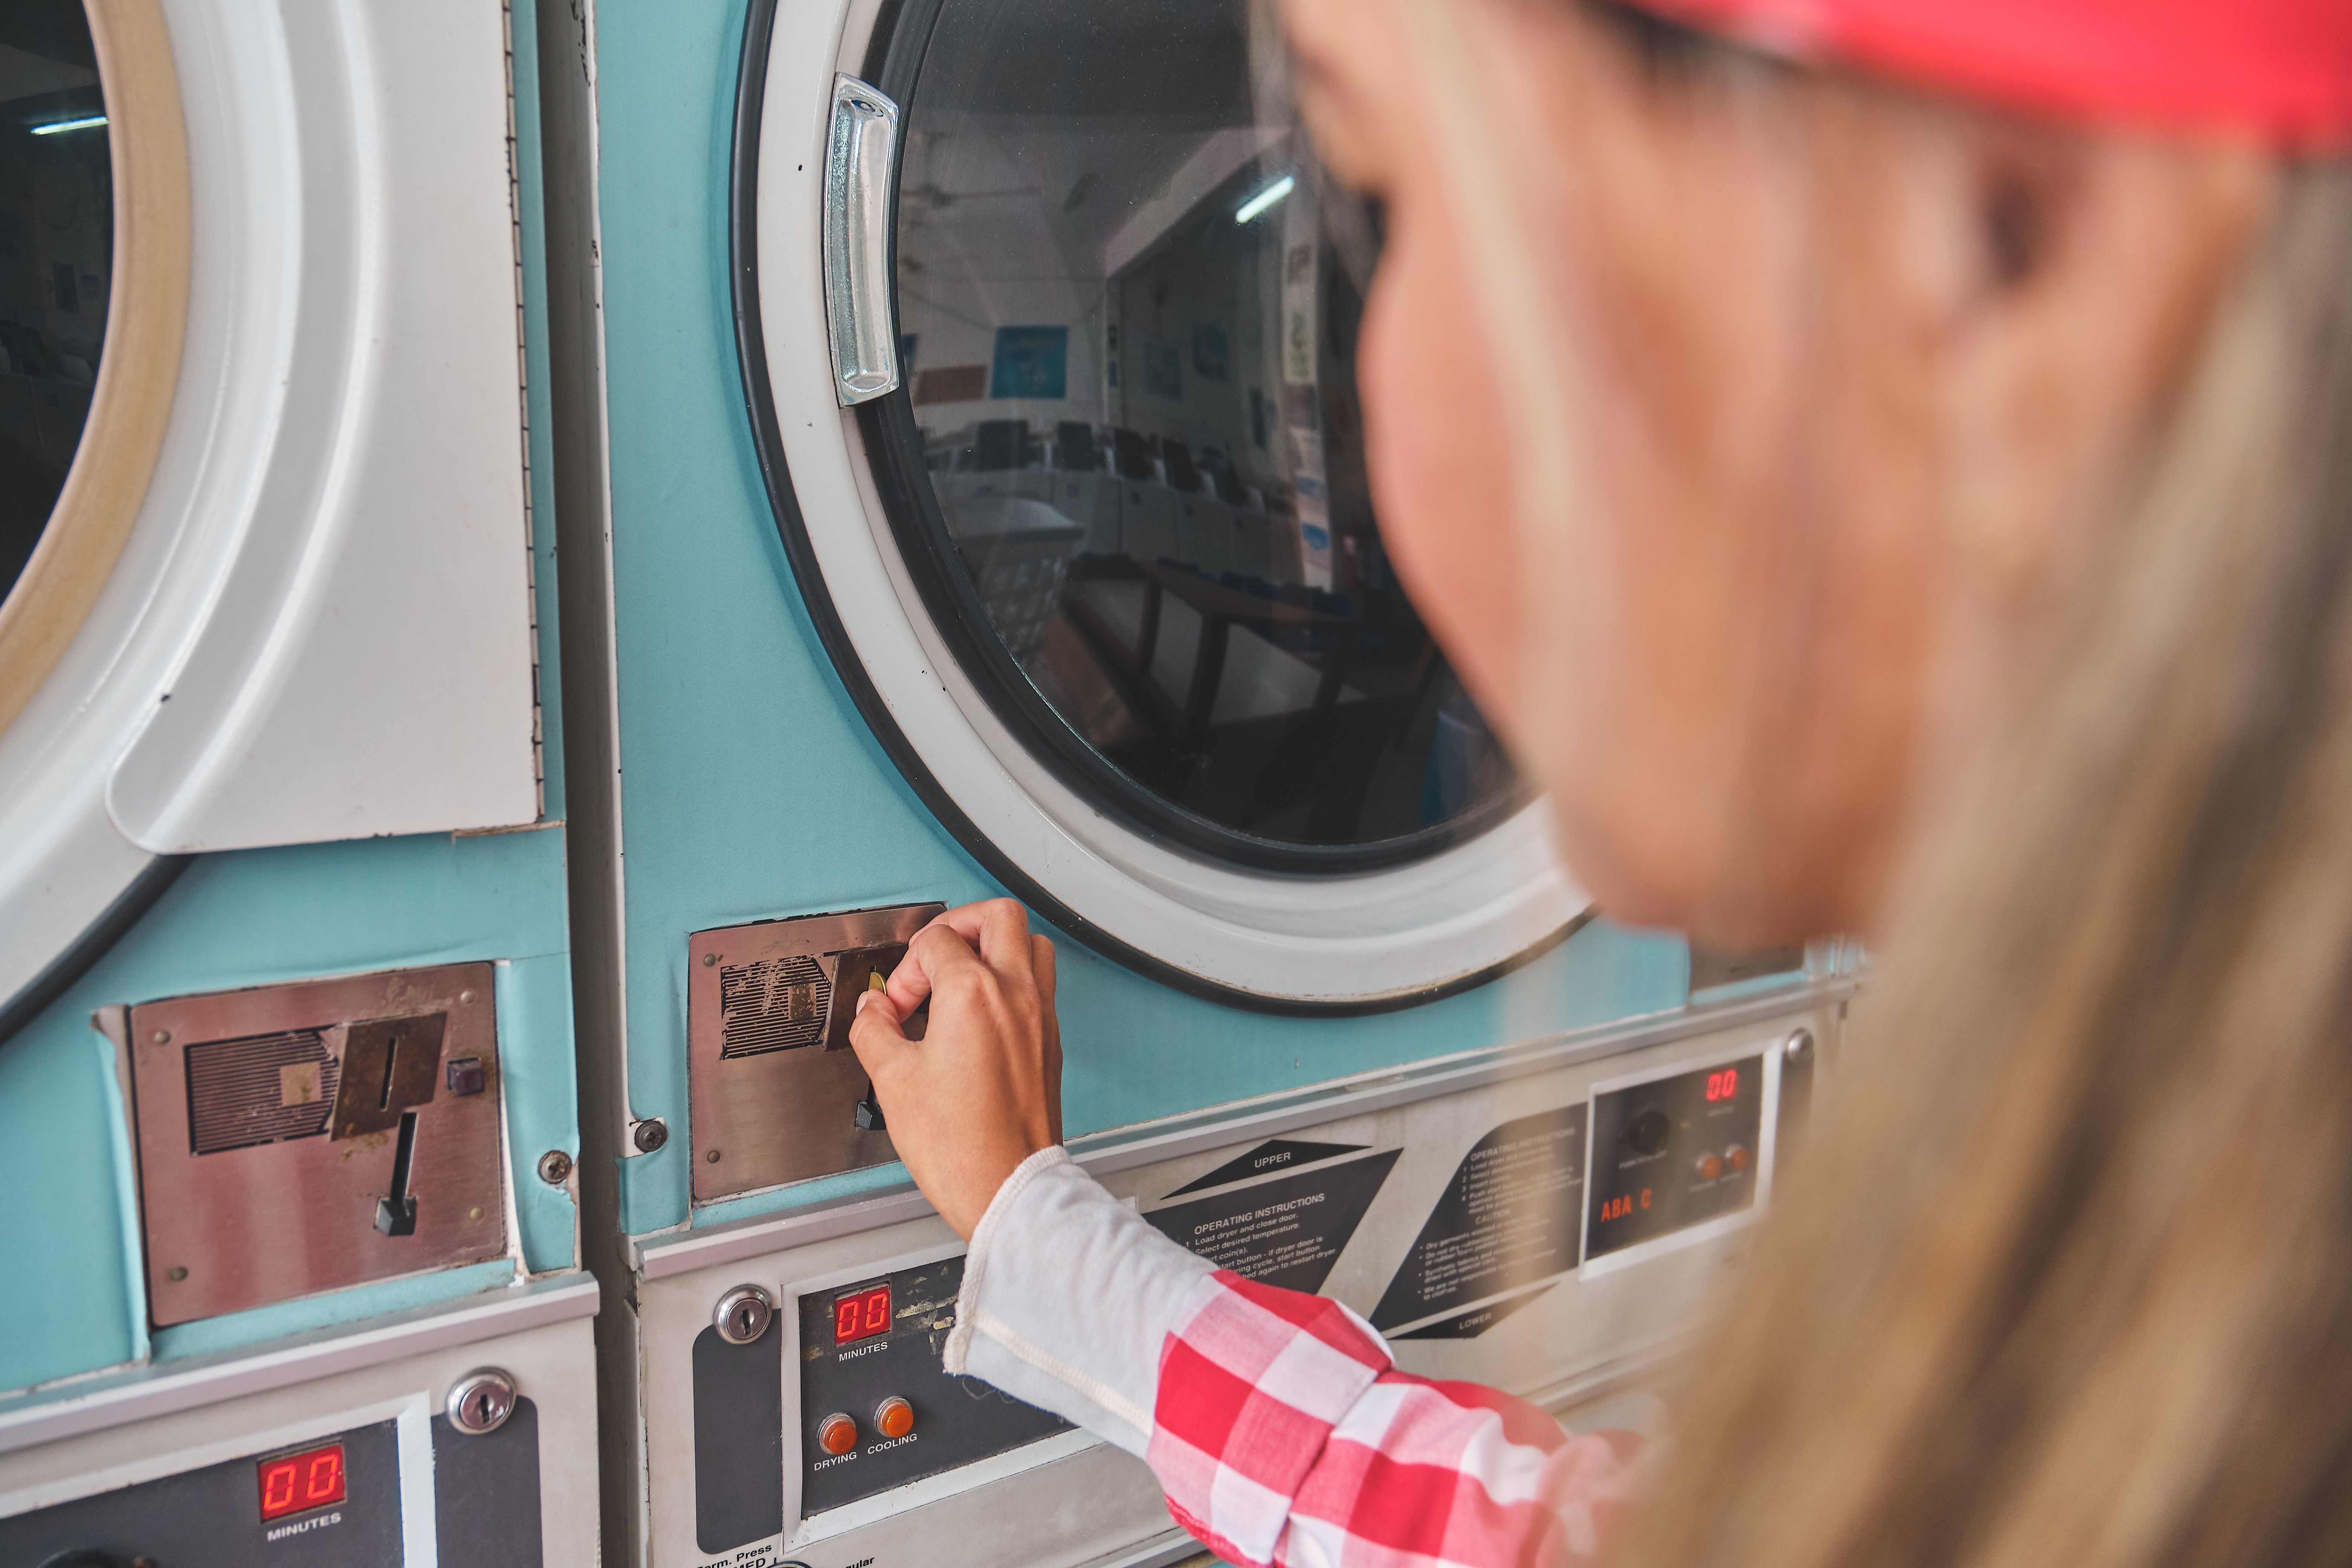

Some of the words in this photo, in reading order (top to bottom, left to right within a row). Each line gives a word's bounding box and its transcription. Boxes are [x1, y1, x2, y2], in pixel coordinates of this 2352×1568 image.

[1706, 1070, 1736, 1101] 00
[1255, 1152, 1291, 1168] UPPER
[1471, 1142, 1516, 1161] OPERATING
[1194, 1212, 1252, 1235] OPERATING
[1255, 1193, 1325, 1218] INSTRUCTIONS
[1476, 1208, 1511, 1225] CAUTION
[1195, 1234, 1215, 1245] Load
[1217, 1229, 1237, 1240] dryer
[1240, 1224, 1254, 1233] and
[1256, 1219, 1277, 1229] close
[1279, 1213, 1299, 1222] door.
[1195, 1244, 1219, 1255] Select
[1222, 1235, 1250, 1248] desired
[1253, 1223, 1300, 1241] temperature.
[1219, 1247, 1248, 1260] coin(s).
[1235, 1265, 1251, 1274] ring
[1277, 1252, 1294, 1262] start
[1296, 1245, 1320, 1256] button
[1237, 1254, 1261, 1265] button
[1276, 1244, 1295, 1254] dryer
[1297, 1239, 1314, 1248] door
[1259, 1265, 1279, 1276] again
[1291, 1254, 1314, 1266] restart
[1317, 1248, 1337, 1258] dryer.
[837, 1293, 887, 1338] 00
[1459, 1312, 1491, 1329] LOWER
[839, 1341, 888, 1362] MINUTES
[814, 1452, 857, 1472] DRYING
[867, 1433, 917, 1455] COOLING
[263, 1454, 339, 1511] 00
[267, 1512, 342, 1542] MINUTES
[737, 1545, 772, 1562] Press
